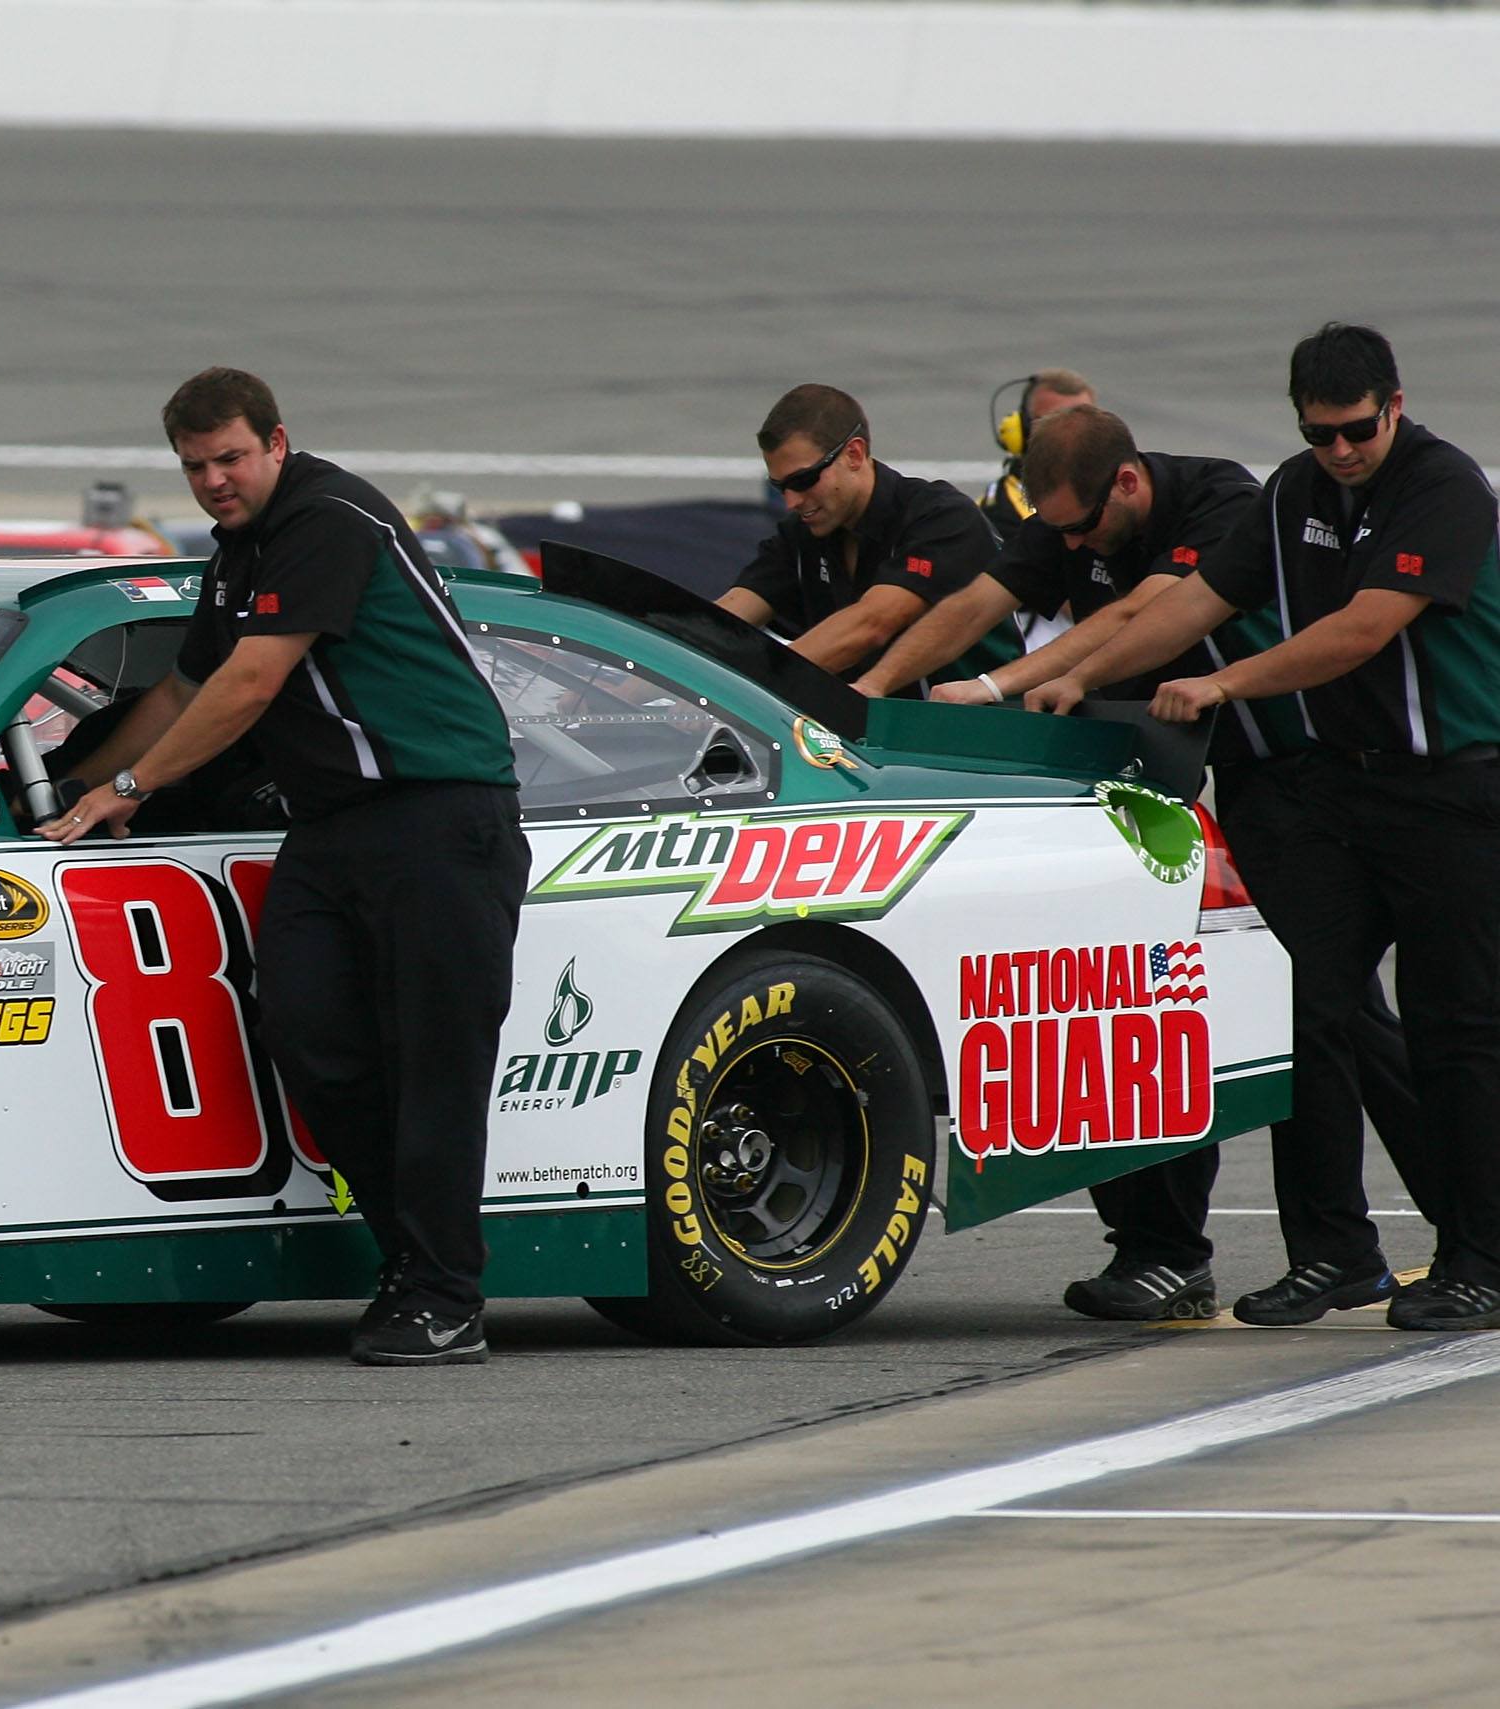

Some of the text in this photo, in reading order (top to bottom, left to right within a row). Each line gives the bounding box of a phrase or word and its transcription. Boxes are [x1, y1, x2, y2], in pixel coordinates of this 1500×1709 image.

[1396, 552, 1424, 576] 88
[1094, 780, 1171, 815] AMERICAN
[1138, 839, 1205, 882] ETHANOL
[2, 958, 49, 977] LIGHT
[960, 943, 1153, 1020] NATIONAL
[53, 855, 350, 1203] 8
[959, 1009, 1211, 1155] GUARD
[499, 1097, 567, 1112] ENERGY
[663, 981, 797, 1246] GOODYEAR
[496, 1163, 638, 1183] www.bethematch.org
[856, 1153, 927, 1295] EAGLE
